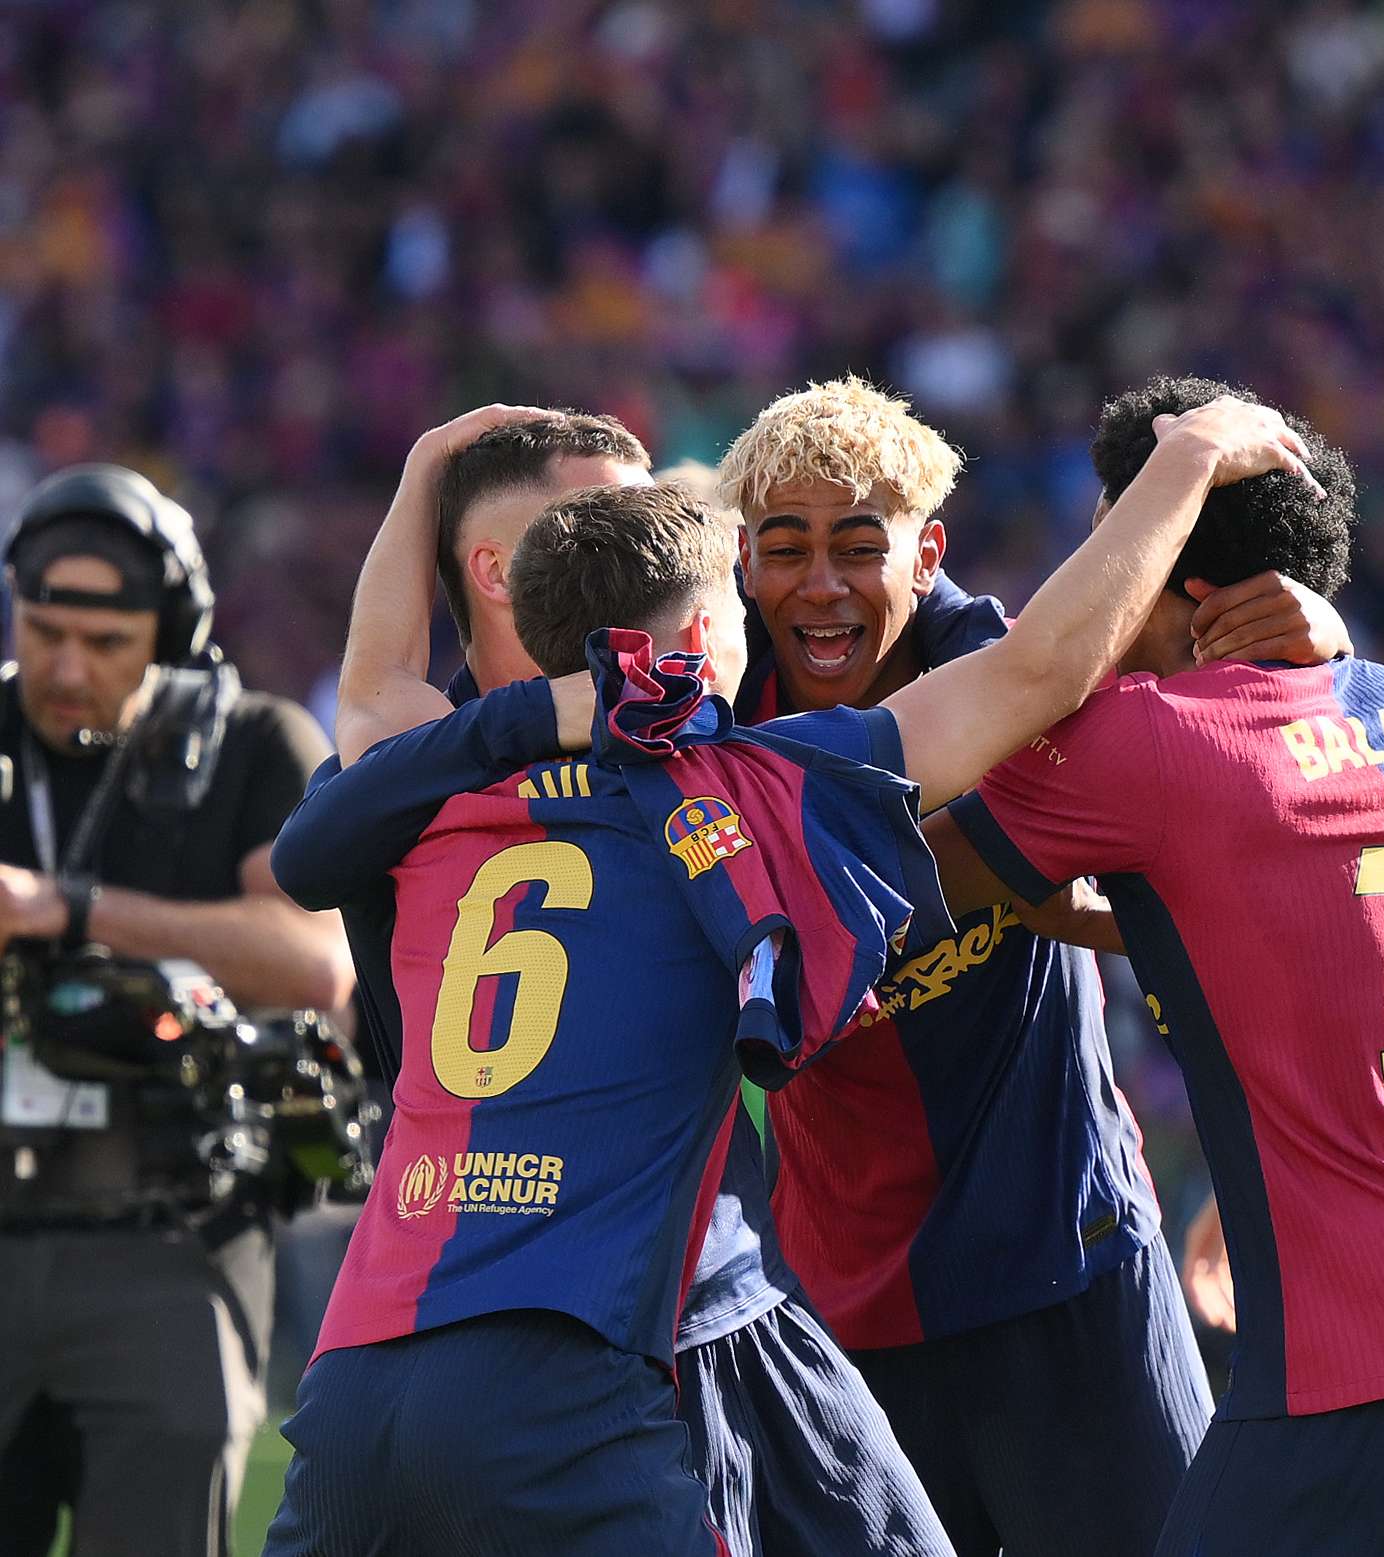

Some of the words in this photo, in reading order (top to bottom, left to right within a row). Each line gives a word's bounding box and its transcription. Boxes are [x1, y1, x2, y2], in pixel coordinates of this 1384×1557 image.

[1048, 747, 1067, 766] tv
[431, 841, 594, 1100] 6
[453, 1152, 564, 1181] UNHCR
[447, 1178, 560, 1205] ACNUR
[447, 1203, 463, 1213] The
[463, 1203, 479, 1213] UN
[479, 1204, 517, 1215] Refugee
[518, 1206, 554, 1217] Agency
